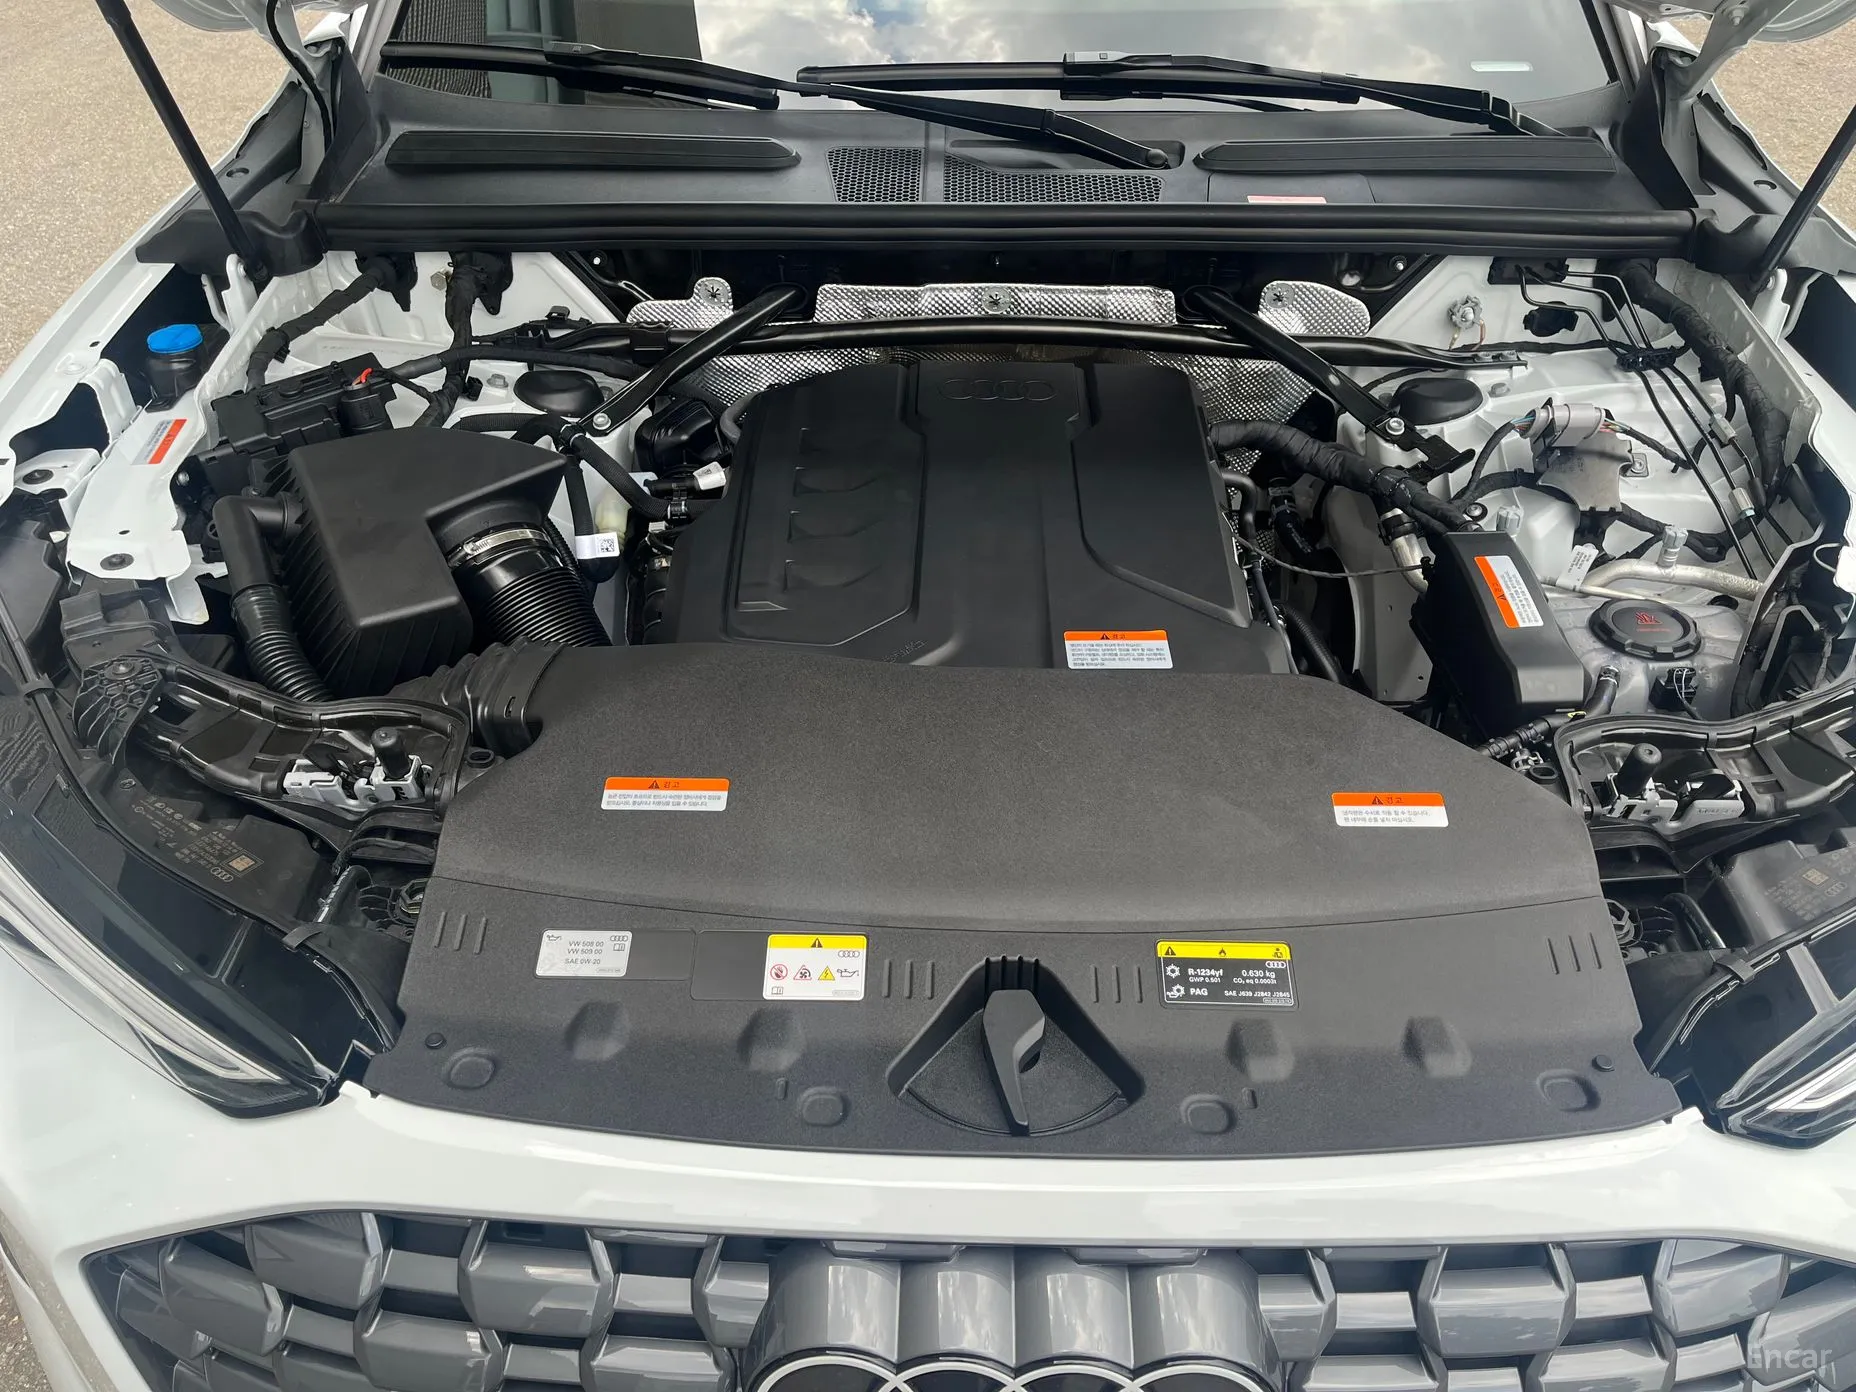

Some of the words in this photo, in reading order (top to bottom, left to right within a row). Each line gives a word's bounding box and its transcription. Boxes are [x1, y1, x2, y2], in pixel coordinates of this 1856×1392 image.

[1188, 968, 1223, 977] R-1234yf
[1265, 970, 1276, 978] kg
[1190, 988, 1208, 996] PAG
